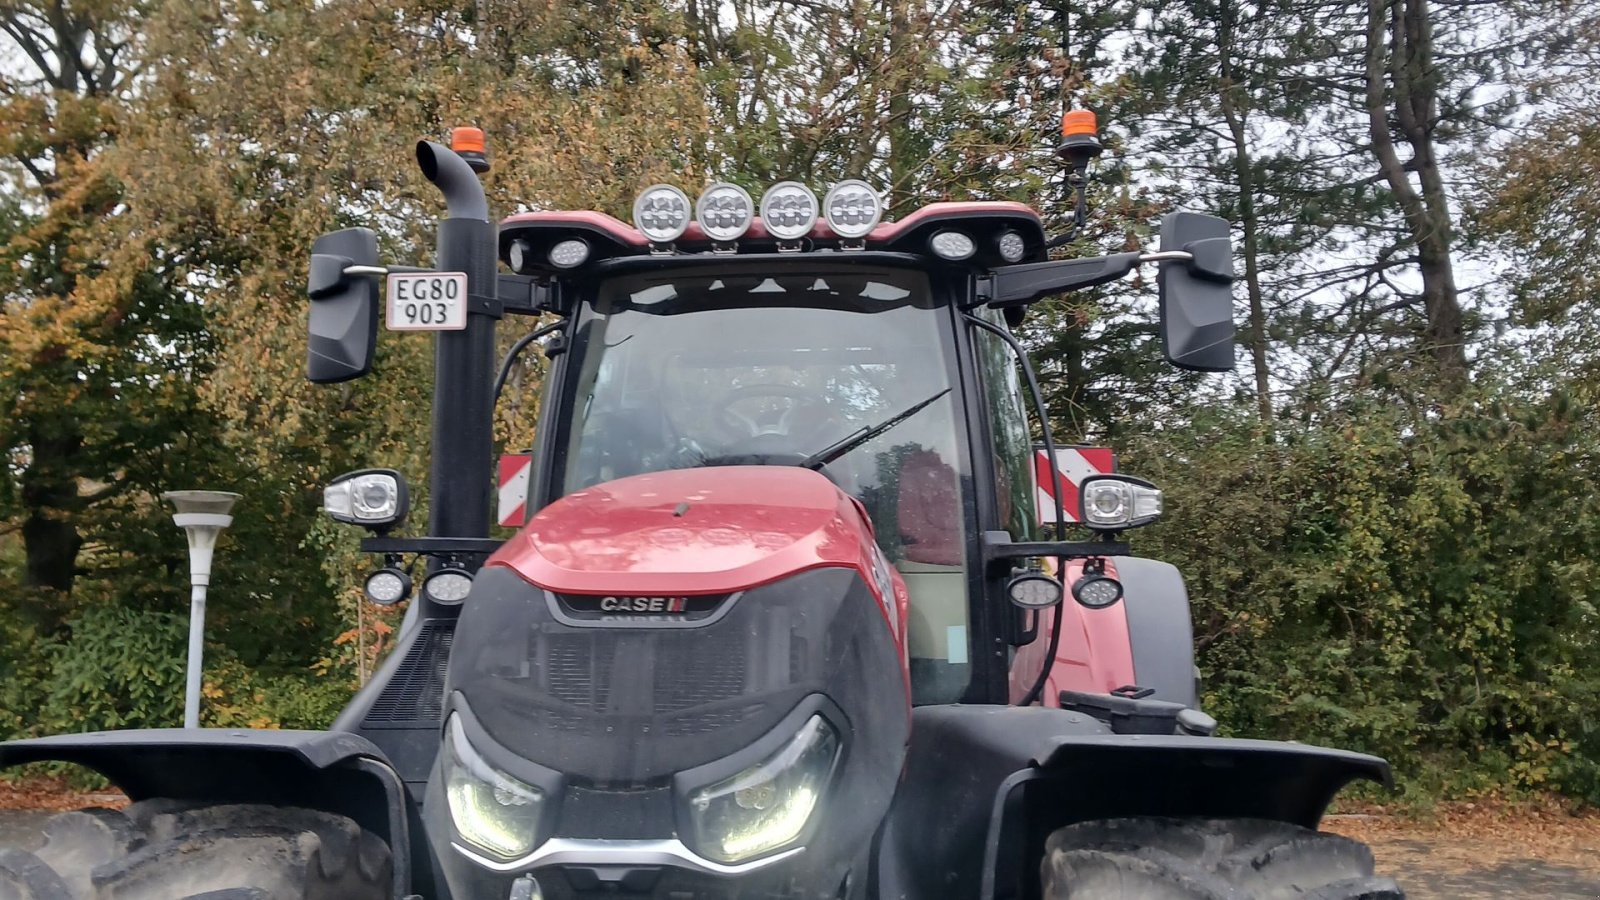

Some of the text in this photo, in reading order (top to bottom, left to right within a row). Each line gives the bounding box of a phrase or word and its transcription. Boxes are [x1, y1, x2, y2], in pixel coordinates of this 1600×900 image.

[397, 278, 458, 300] EG80
[405, 303, 447, 324] 903
[600, 596, 665, 612] CASE
